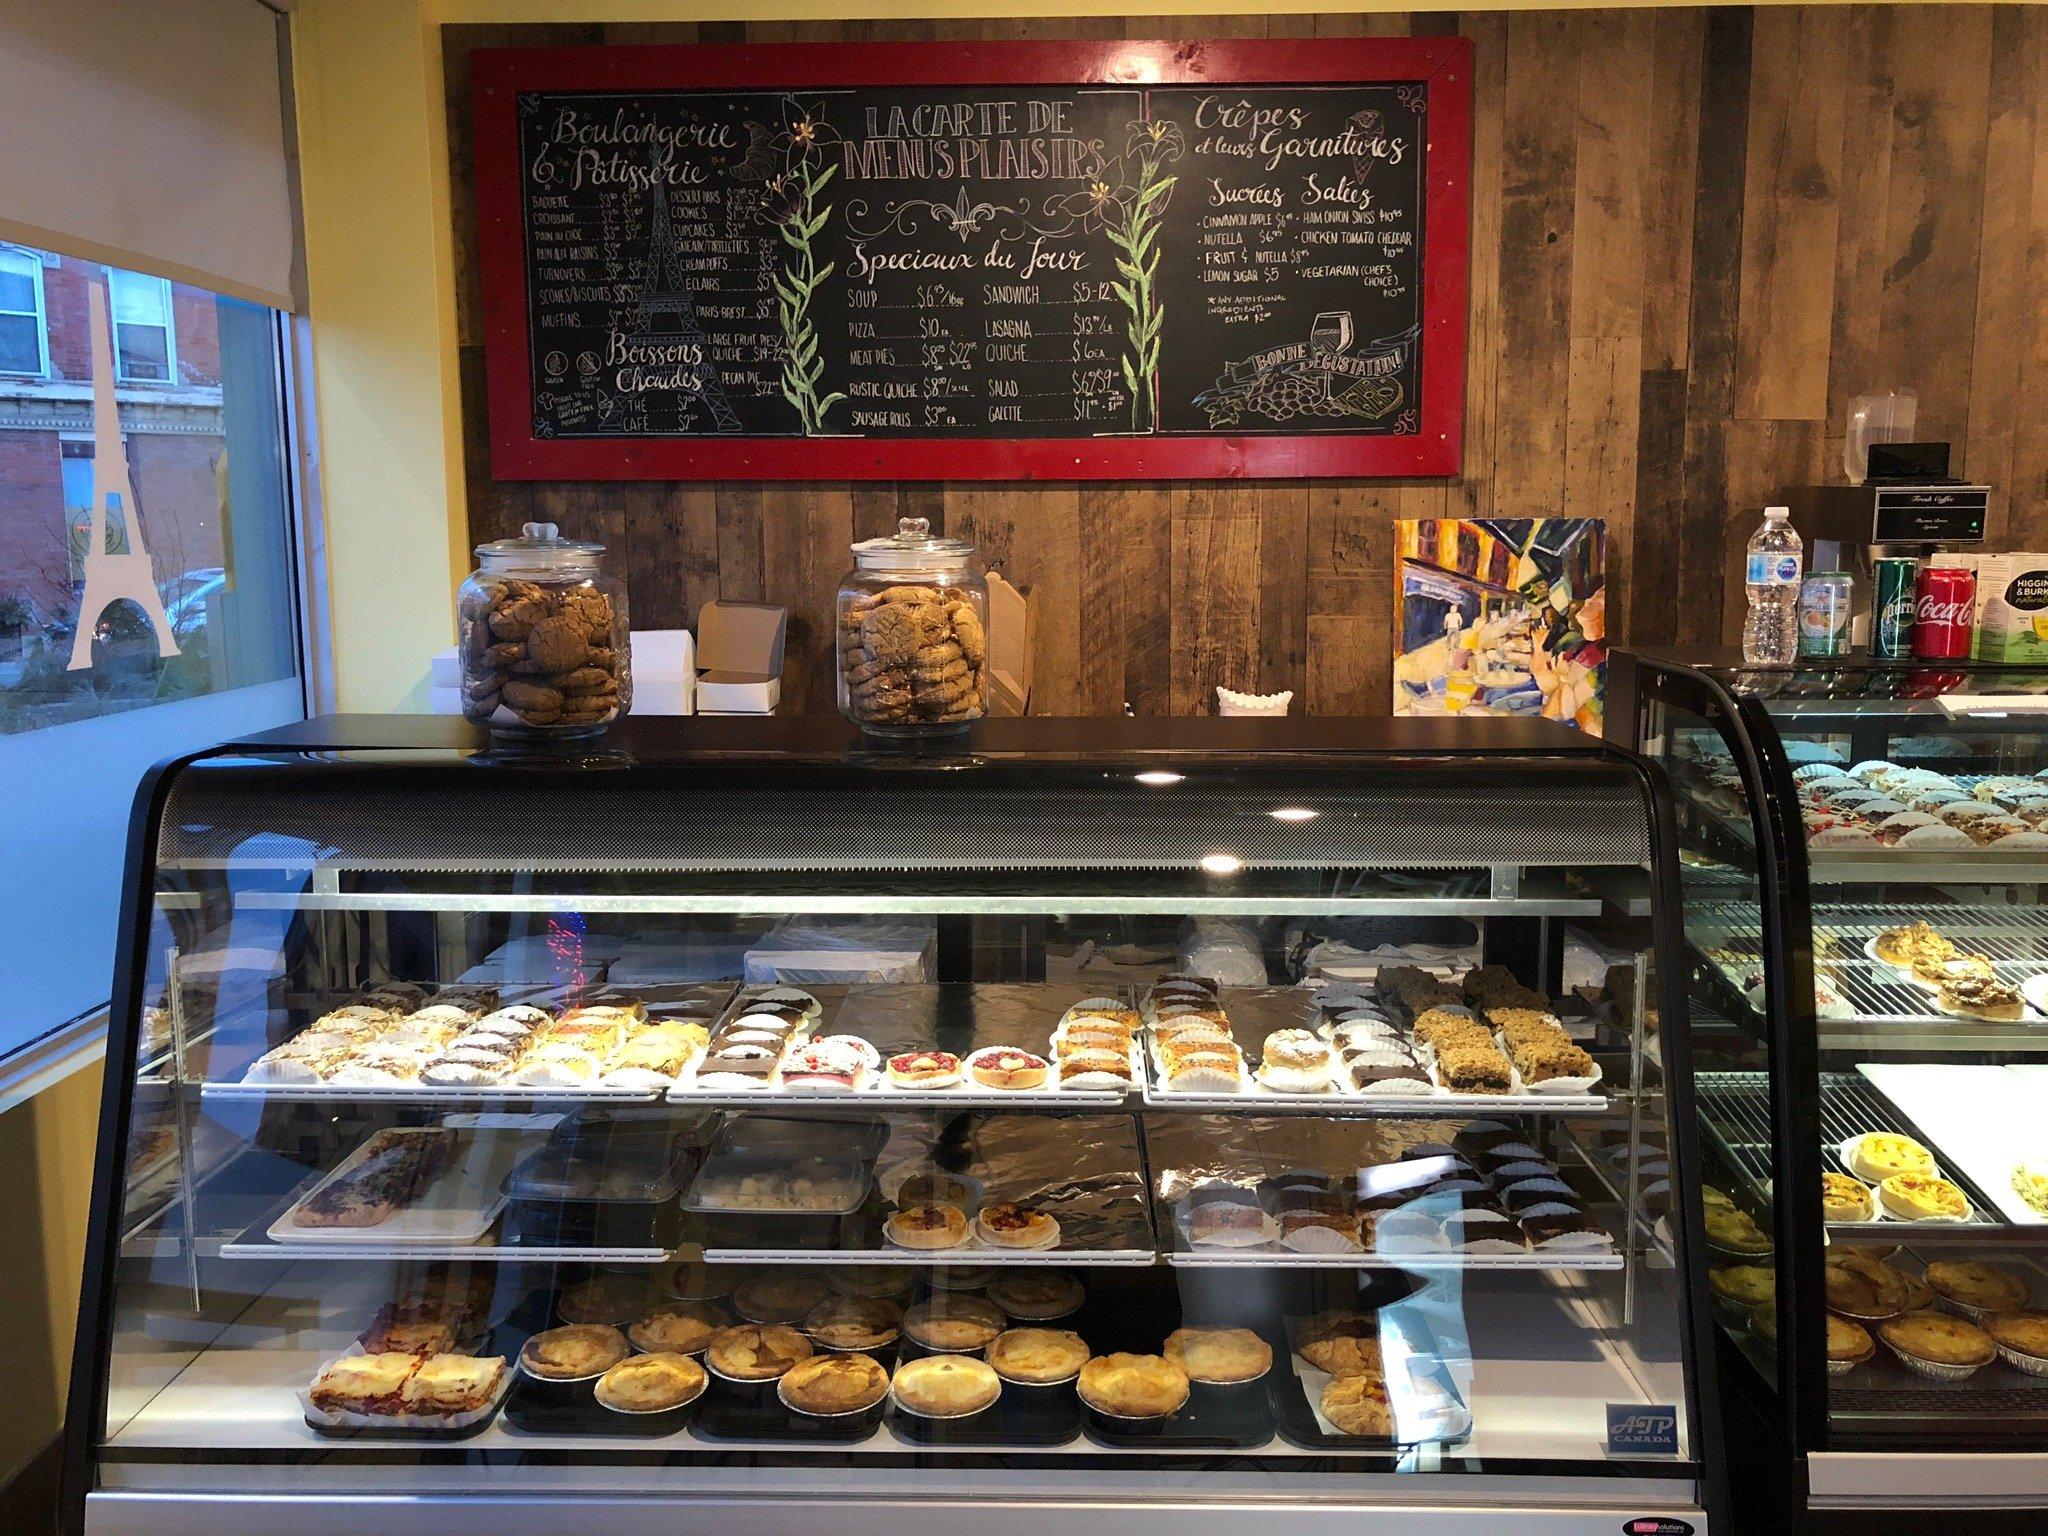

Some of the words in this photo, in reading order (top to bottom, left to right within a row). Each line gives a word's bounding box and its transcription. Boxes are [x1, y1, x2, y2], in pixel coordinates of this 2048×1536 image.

[865, 105, 913, 139] LA
[912, 101, 1018, 137] CARTE
[1027, 101, 1073, 134] DE
[1193, 95, 1311, 141] Crêpes
[551, 105, 738, 166] Boulangerie
[1194, 137, 1211, 154] et
[1214, 136, 1256, 158] leurs
[1259, 126, 1409, 171] Garnitures
[843, 138, 954, 180] MENUS
[959, 138, 1106, 180] PLAISIRS
[670, 190, 702, 204] DESSERT
[703, 190, 720, 204] BARS
[1207, 177, 1285, 207] Sucrées
[1300, 173, 1375, 210] Salées
[532, 195, 570, 208] BAGUETTE
[532, 212, 575, 225] CROISSANT
[670, 206, 708, 220] COOKIES
[1203, 214, 1247, 228] CINNAMON
[1249, 213, 1272, 226] APPLE
[1303, 211, 1322, 224] HAM
[1324, 210, 1349, 223] ONION
[1352, 210, 1375, 224] SWISS
[534, 231, 553, 241] PAIN
[672, 223, 715, 237] CUPCAKES
[1204, 231, 1243, 245] NUTELLA
[1300, 231, 1338, 244] CHICKEN
[1341, 231, 1374, 244] TOMATO
[1377, 231, 1412, 246] CHEDDAR
[536, 247, 552, 260] PAIN
[569, 245, 599, 260] RAISINS
[846, 242, 979, 285] Speciaux
[984, 239, 1016, 269] du
[1020, 236, 1091, 279] Jour
[1205, 251, 1236, 265] FRUIT
[1255, 250, 1288, 263] NUTELLA
[680, 257, 706, 271] CREAM
[706, 256, 728, 271] PUFFS
[1301, 265, 1359, 278] VEGETARIAN
[537, 267, 586, 281] TURNOVERS
[1203, 270, 1230, 282] LEMON
[1233, 269, 1258, 282] SUGAR
[1264, 267, 1279, 283] $5
[1363, 274, 1398, 287] CHOICE)
[685, 275, 720, 291] ÉCLAIRS
[847, 288, 878, 308] SOUP
[983, 283, 1039, 305] SANDWICH
[1234, 294, 1286, 304] ADDITIONAL
[541, 311, 581, 328] MUFFINS
[848, 322, 876, 338] PIZZA
[984, 319, 1032, 339] LASAGNA
[605, 327, 704, 367] Boissons
[707, 333, 731, 346] LARGE
[734, 333, 756, 345] FRUIT
[712, 346, 742, 362] QUICHE
[850, 350, 872, 366] MEAT
[875, 348, 895, 367] PIES
[985, 343, 1029, 362] QUICHE
[1254, 343, 1308, 370] BONNE
[616, 367, 704, 393] Chaudes
[721, 371, 744, 385] PECAN
[747, 371, 760, 385] PIE
[849, 382, 881, 398] RUSTIC
[883, 382, 918, 399] QUICHE
[988, 379, 1018, 397] SALAD
[851, 411, 888, 427] SAUSAGE
[890, 411, 911, 427] ROLLS
[988, 405, 1022, 423] GALETTE
[1614, 1435, 1672, 1443] CANADA
